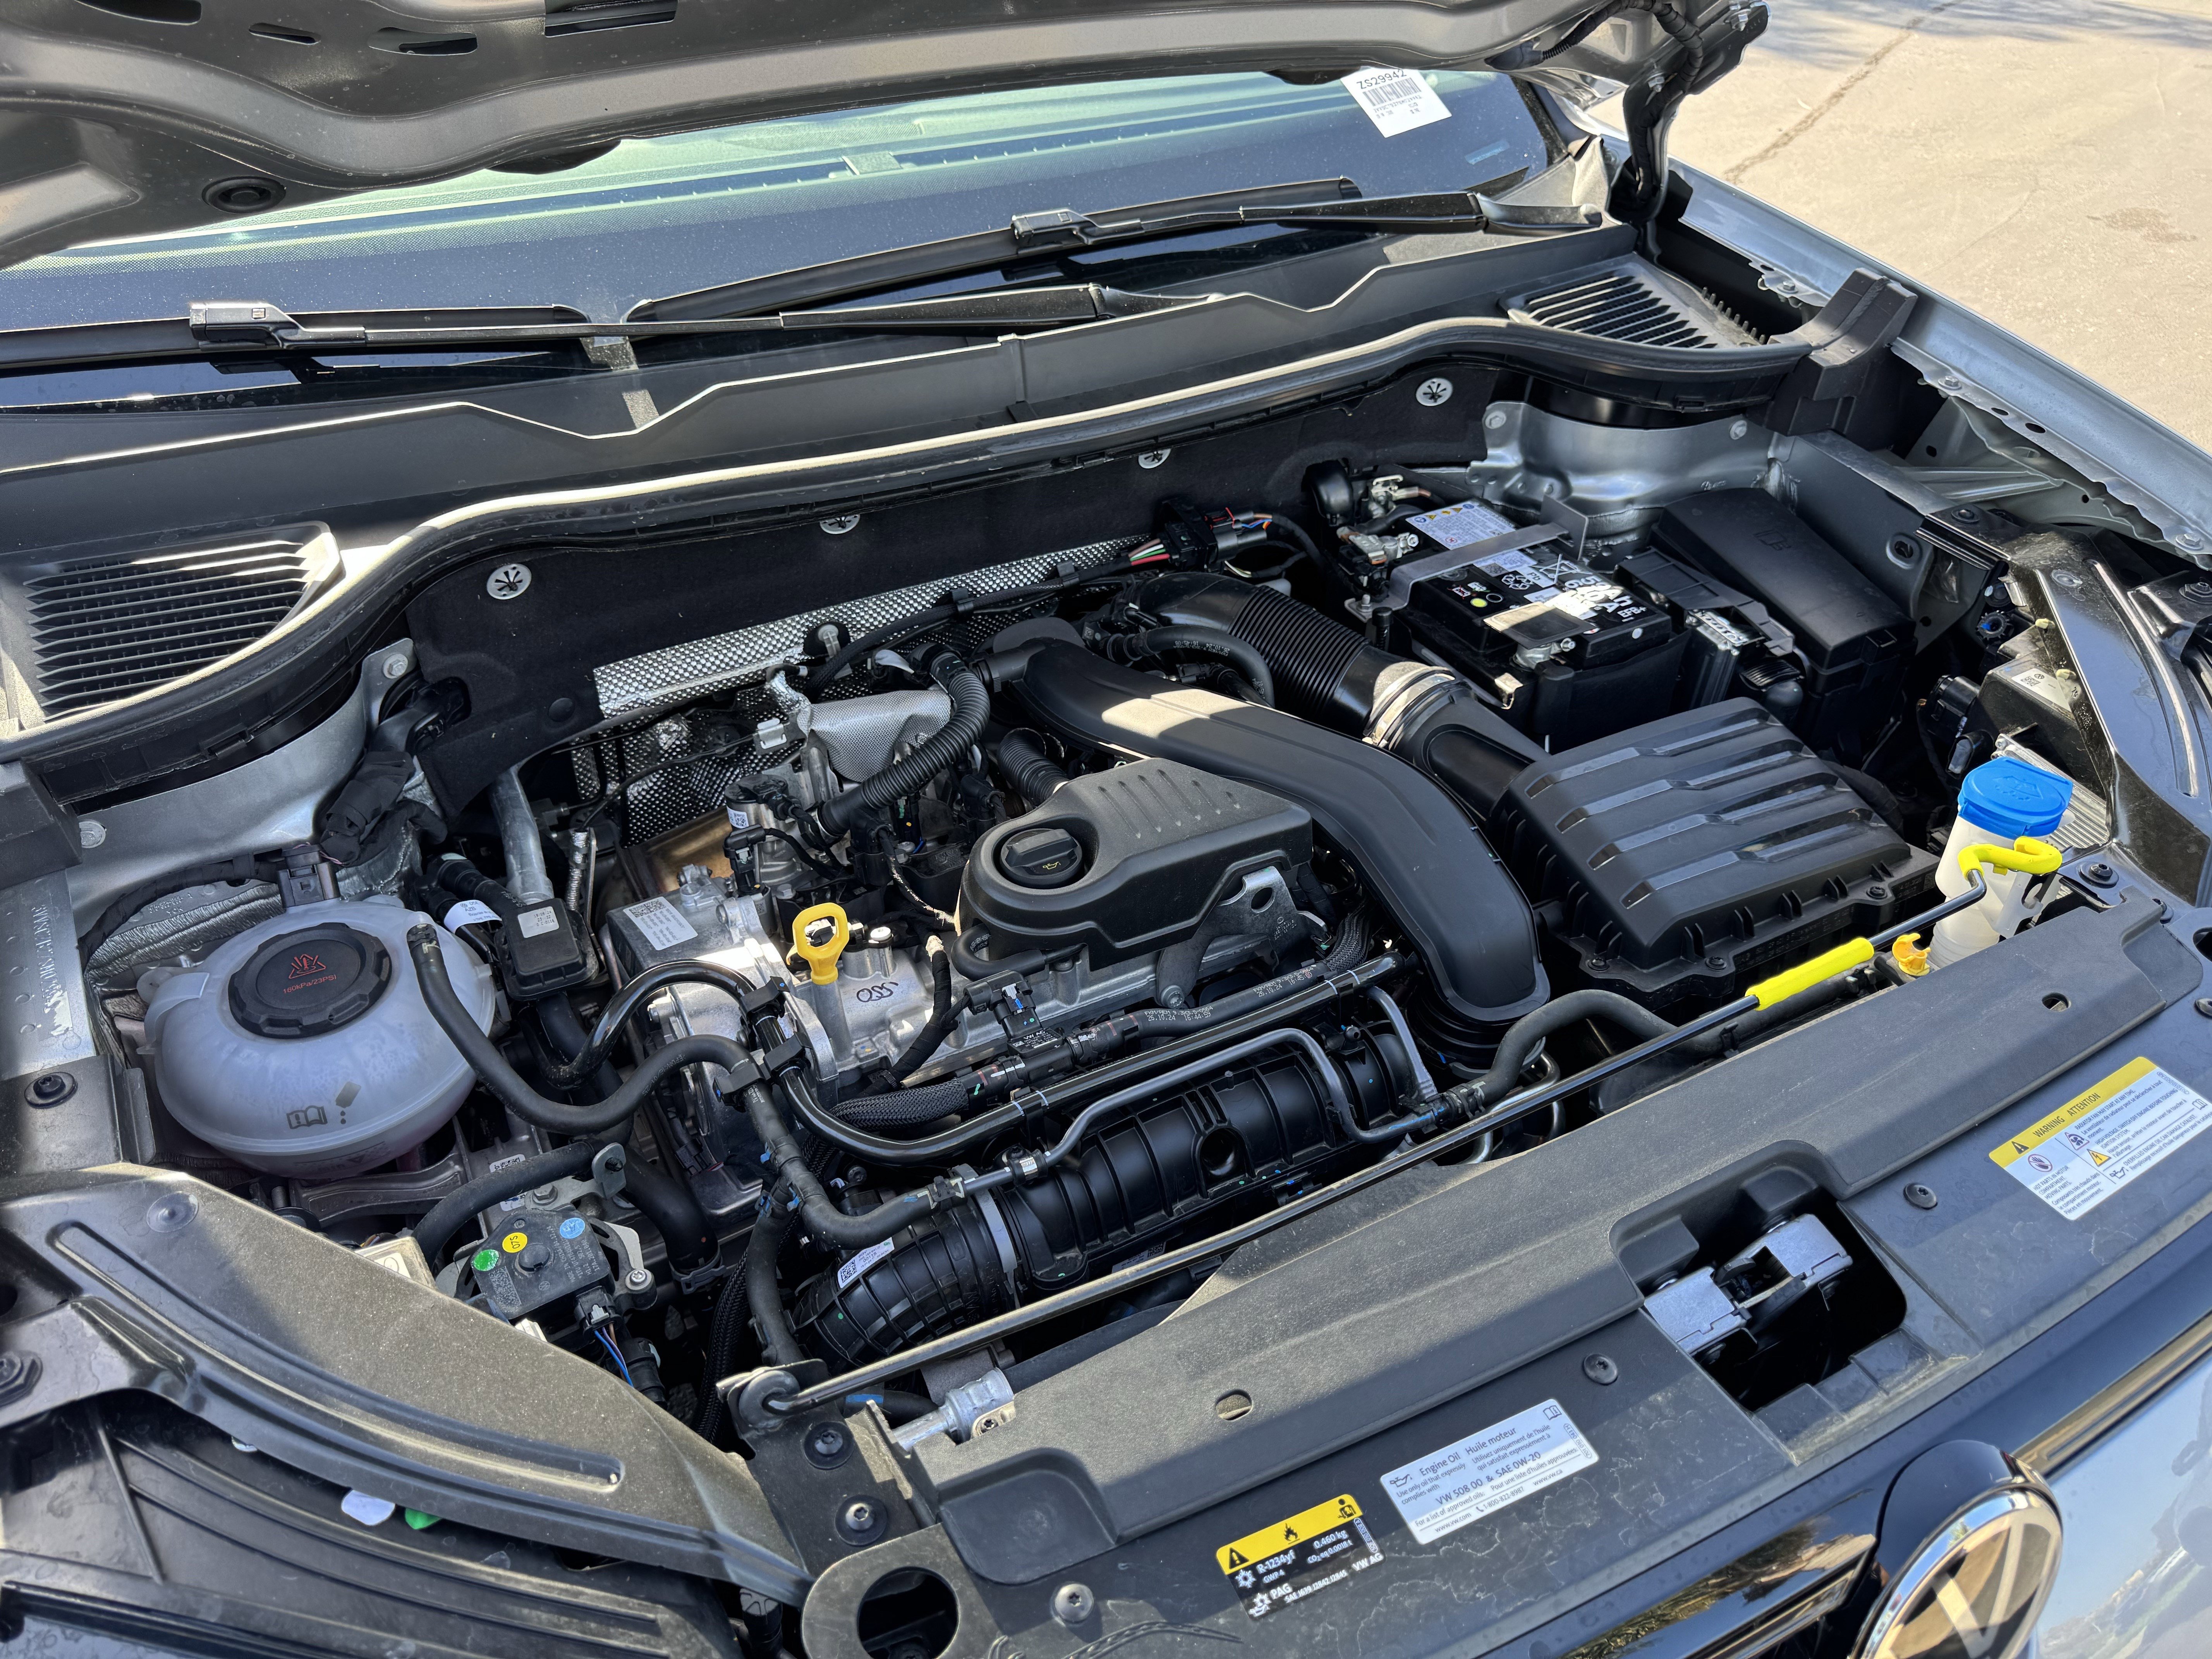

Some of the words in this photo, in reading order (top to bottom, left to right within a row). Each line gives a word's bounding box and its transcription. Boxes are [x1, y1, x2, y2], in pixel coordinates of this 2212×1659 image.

[1357, 70, 1407, 89] ZS29942
[1527, 572, 1540, 581] Pb
[1617, 606, 1647, 618] EFB+
[283, 974, 337, 994] 160kPa/23PSI
[1257, 983, 1282, 997] 26.10.24
[1184, 1012, 1211, 1021] 16:44:59
[2032, 1115, 2066, 1139] WARNING
[2064, 1091, 2102, 1117] ATTENTION
[2074, 1117, 2094, 1130] RADIATOR
[2104, 1101, 2117, 1110] START
[2124, 1088, 2136, 1097] TIME.
[2100, 1137, 2118, 1149] IGNITION
[2114, 1128, 2131, 1139] SYSTEM.
[2039, 1176, 2054, 1186] PARTS
[2054, 1165, 2070, 1176] MOTOR
[2044, 1188, 2061, 1199] MOVING
[2057, 1180, 2073, 1190] PARTS.
[1419, 1457, 1450, 1479] Engine
[1446, 1452, 1461, 1463] Oil
[1465, 1439, 1488, 1455] Huile
[1487, 1427, 1518, 1445] moteur
[1471, 1450, 1494, 1464] Utilisez
[1492, 1435, 1528, 1455] uniquement
[1532, 1423, 1551, 1435] l'huile
[1476, 1462, 1488, 1472] qui
[1485, 1452, 1509, 1466] satisfait
[1508, 1434, 1547, 1457] expressément
[1435, 1492, 1454, 1506] VW
[1452, 1483, 1472, 1498] 508
[1469, 1477, 1484, 1490] 00
[1485, 1474, 1494, 1482] &
[1494, 1463, 1513, 1478] SAE
[1511, 1450, 1542, 1470] 0W-20
[1490, 1480, 1505, 1491] Pour
[1504, 1477, 1516, 1485] une
[1514, 1470, 1527, 1480] liste
[1525, 1460, 1547, 1474] d'huiles
[1546, 1446, 1580, 1466] approuvées:
[1396, 1488, 1409, 1498] Use
[1407, 1482, 1422, 1494] only
[1427, 1474, 1441, 1483] that
[1439, 1462, 1467, 1479] expressly
[1400, 1489, 1427, 1506] complies
[1425, 1482, 1440, 1493] with
[1434, 1511, 1472, 1534] www.vw.com
[1482, 1486, 1525, 1510] 1-800-822-8987
[1532, 1468, 1563, 1486] www.vw.ca
[1414, 1518, 1426, 1527] For
[1429, 1511, 1440, 1520] list
[1438, 1508, 1447, 1516] of
[1445, 1495, 1474, 1513] approved
[1471, 1489, 1485, 1500] oils:
[1313, 1532, 1338, 1549] 0.460
[1335, 1528, 1349, 1542] kg
[1256, 1549, 1298, 1577] R-1234yf
[1352, 1558, 1370, 1571] VW
[1369, 1551, 1384, 1564] AG
[1262, 1571, 1279, 1584] GWP
[1278, 1569, 1285, 1577] 4
[1269, 1582, 1292, 1599] PAG
